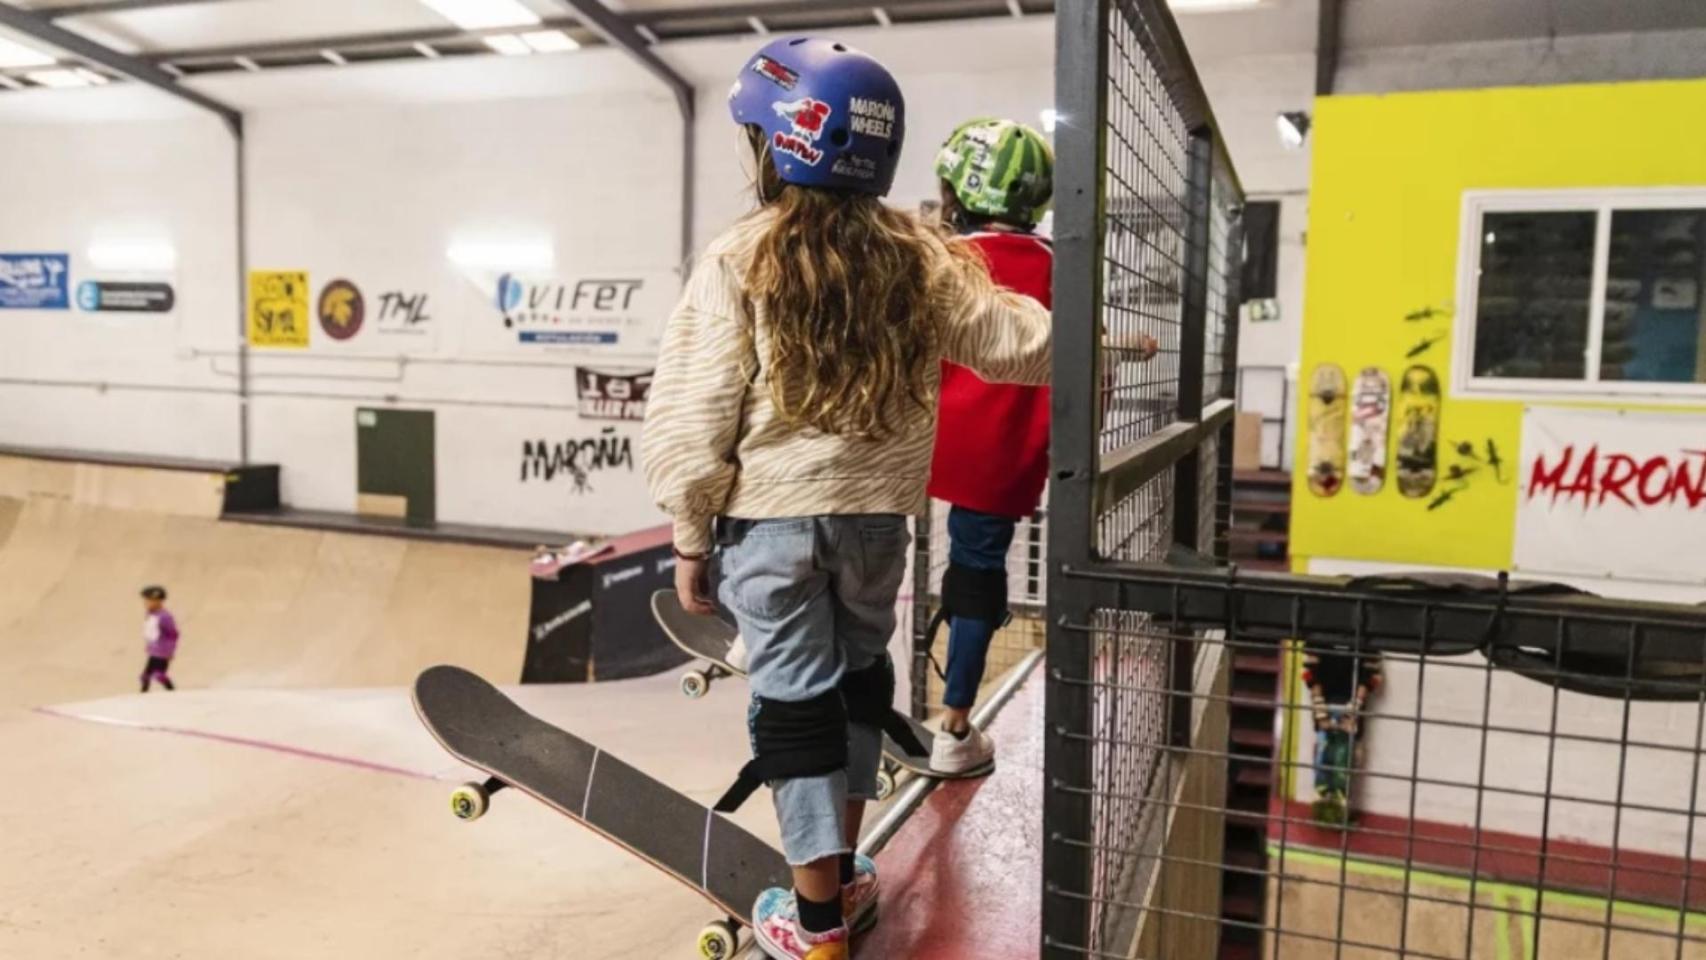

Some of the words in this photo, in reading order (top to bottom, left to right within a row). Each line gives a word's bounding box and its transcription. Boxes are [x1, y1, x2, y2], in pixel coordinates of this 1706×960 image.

[851, 115, 893, 138] WHEELS
[378, 291, 431, 325] TML
[521, 427, 632, 482] MAROÑA
[1528, 444, 1706, 516] MAROÑ
